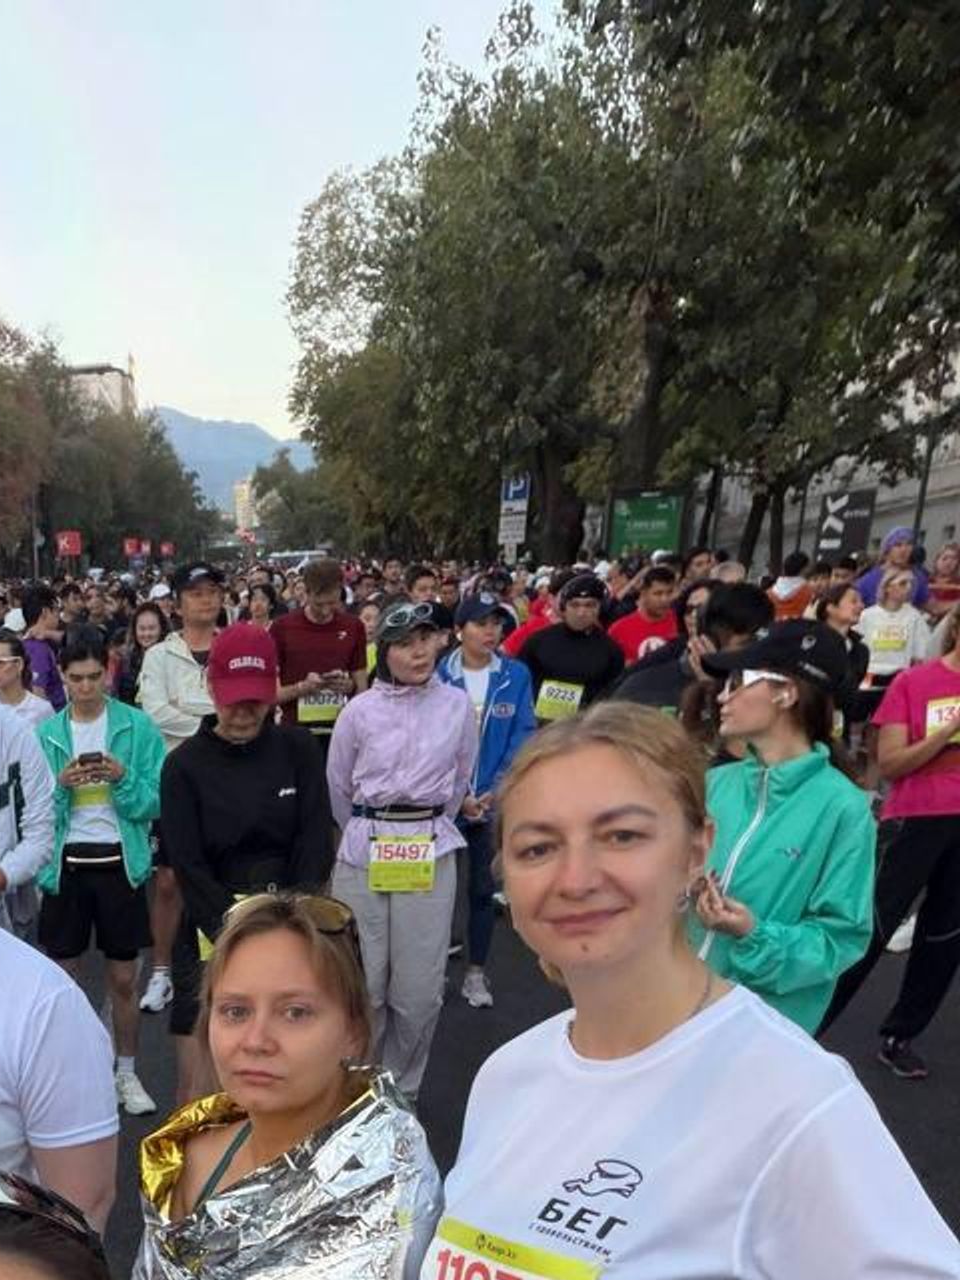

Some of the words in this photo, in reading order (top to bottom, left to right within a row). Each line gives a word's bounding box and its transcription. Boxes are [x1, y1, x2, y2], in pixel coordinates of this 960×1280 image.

[508, 478, 524, 499] P
[375, 844, 430, 860] 15497
[538, 1198, 628, 1240] БЕГ
